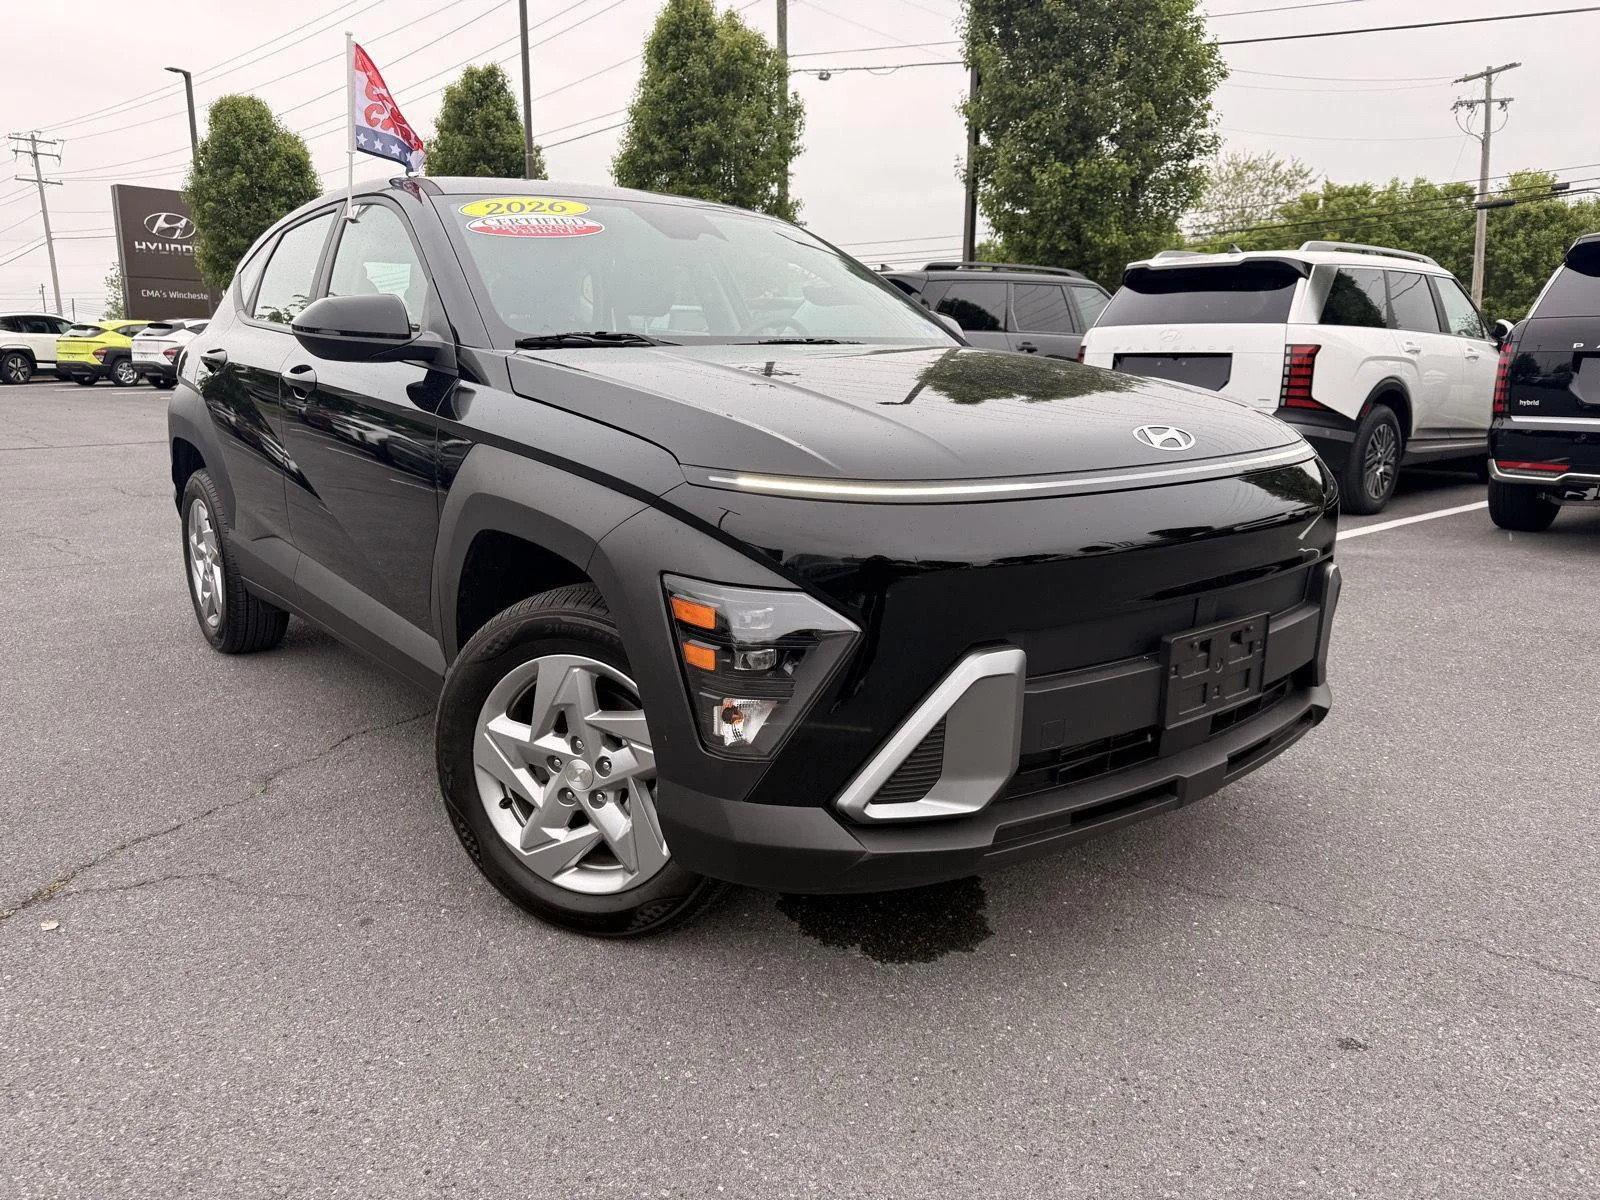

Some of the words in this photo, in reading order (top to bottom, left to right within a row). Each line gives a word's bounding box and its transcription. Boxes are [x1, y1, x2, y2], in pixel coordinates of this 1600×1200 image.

[485, 201, 567, 215] 2026
[481, 216, 587, 226] CERTIFIED
[141, 289, 167, 299] CMA's
[168, 290, 209, 300] Wincheste
[1519, 399, 1540, 407] hybrid
